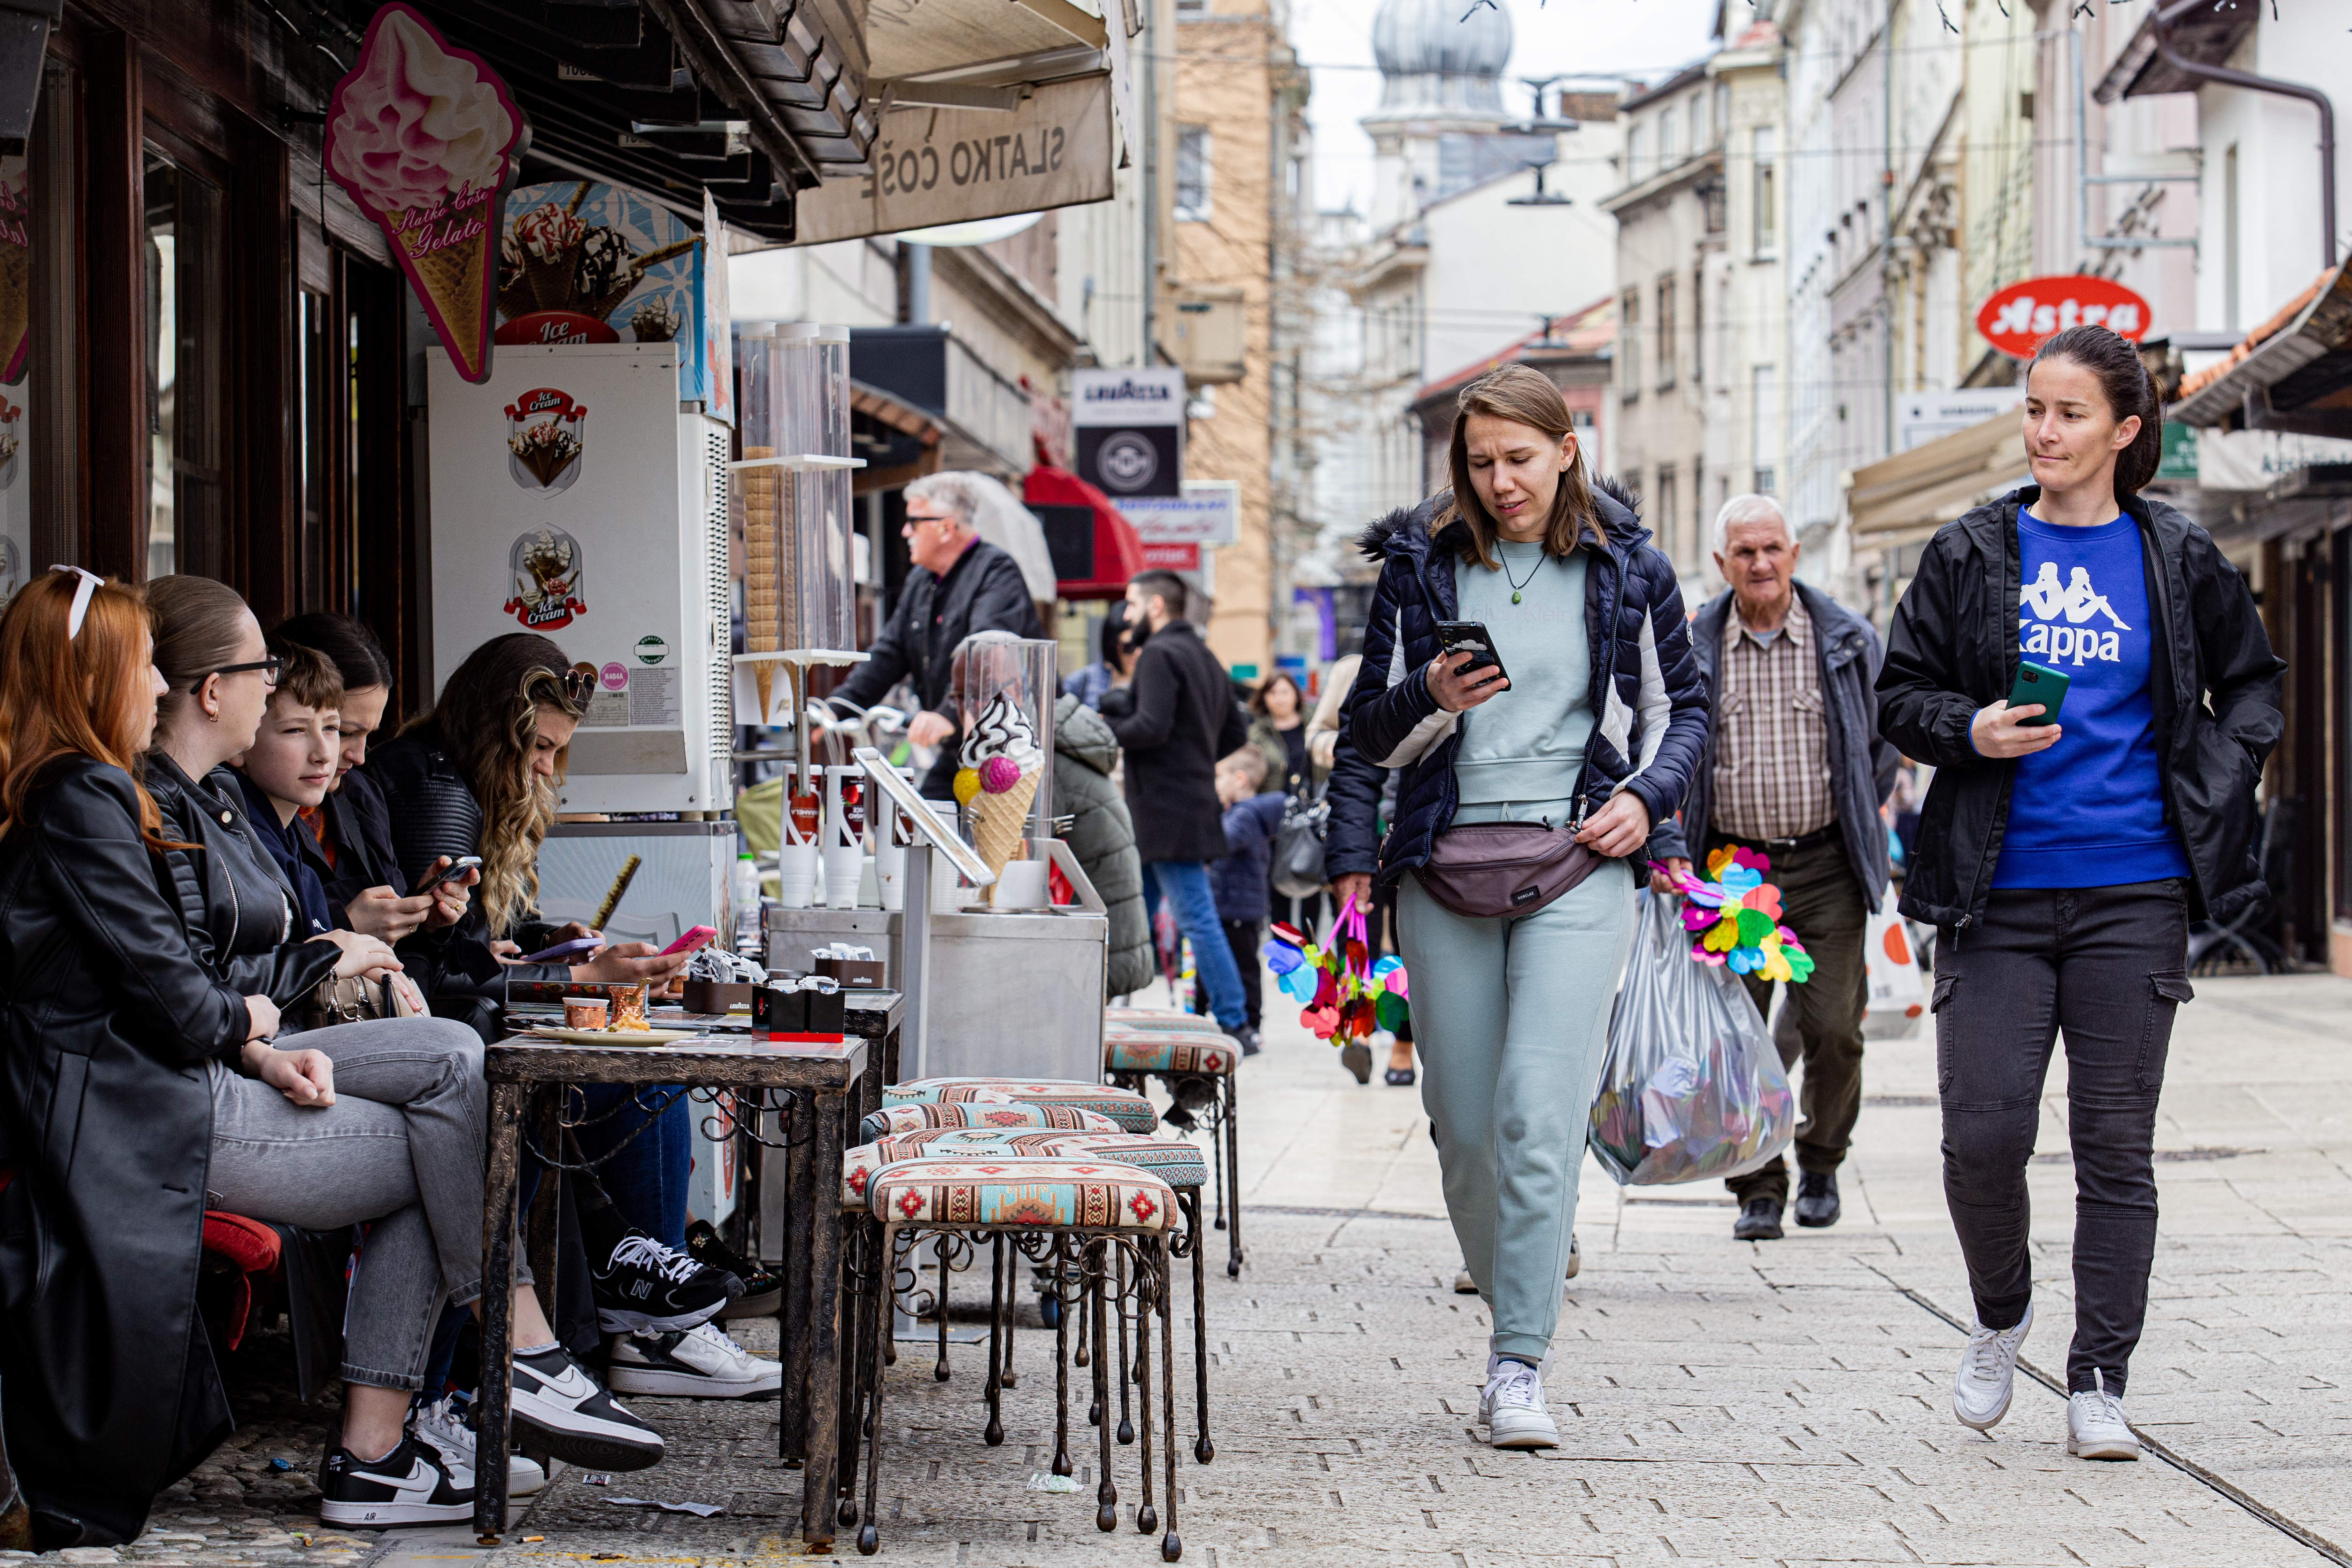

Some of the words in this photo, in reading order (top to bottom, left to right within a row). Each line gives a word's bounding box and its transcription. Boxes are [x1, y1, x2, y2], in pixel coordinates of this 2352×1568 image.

[392, 201, 447, 234] Slatko
[409, 218, 485, 258] Gelato
[1990, 296, 2140, 335] Astra
[540, 321, 569, 342] Ice
[529, 397, 561, 411] Cream
[538, 392, 552, 402] Ice
[538, 601, 555, 613] Ice
[527, 608, 565, 624] Cream
[1518, 891, 1535, 900] FORCLAZ
[630, 1278, 654, 1301] N
[363, 1512, 377, 1521] AIR
